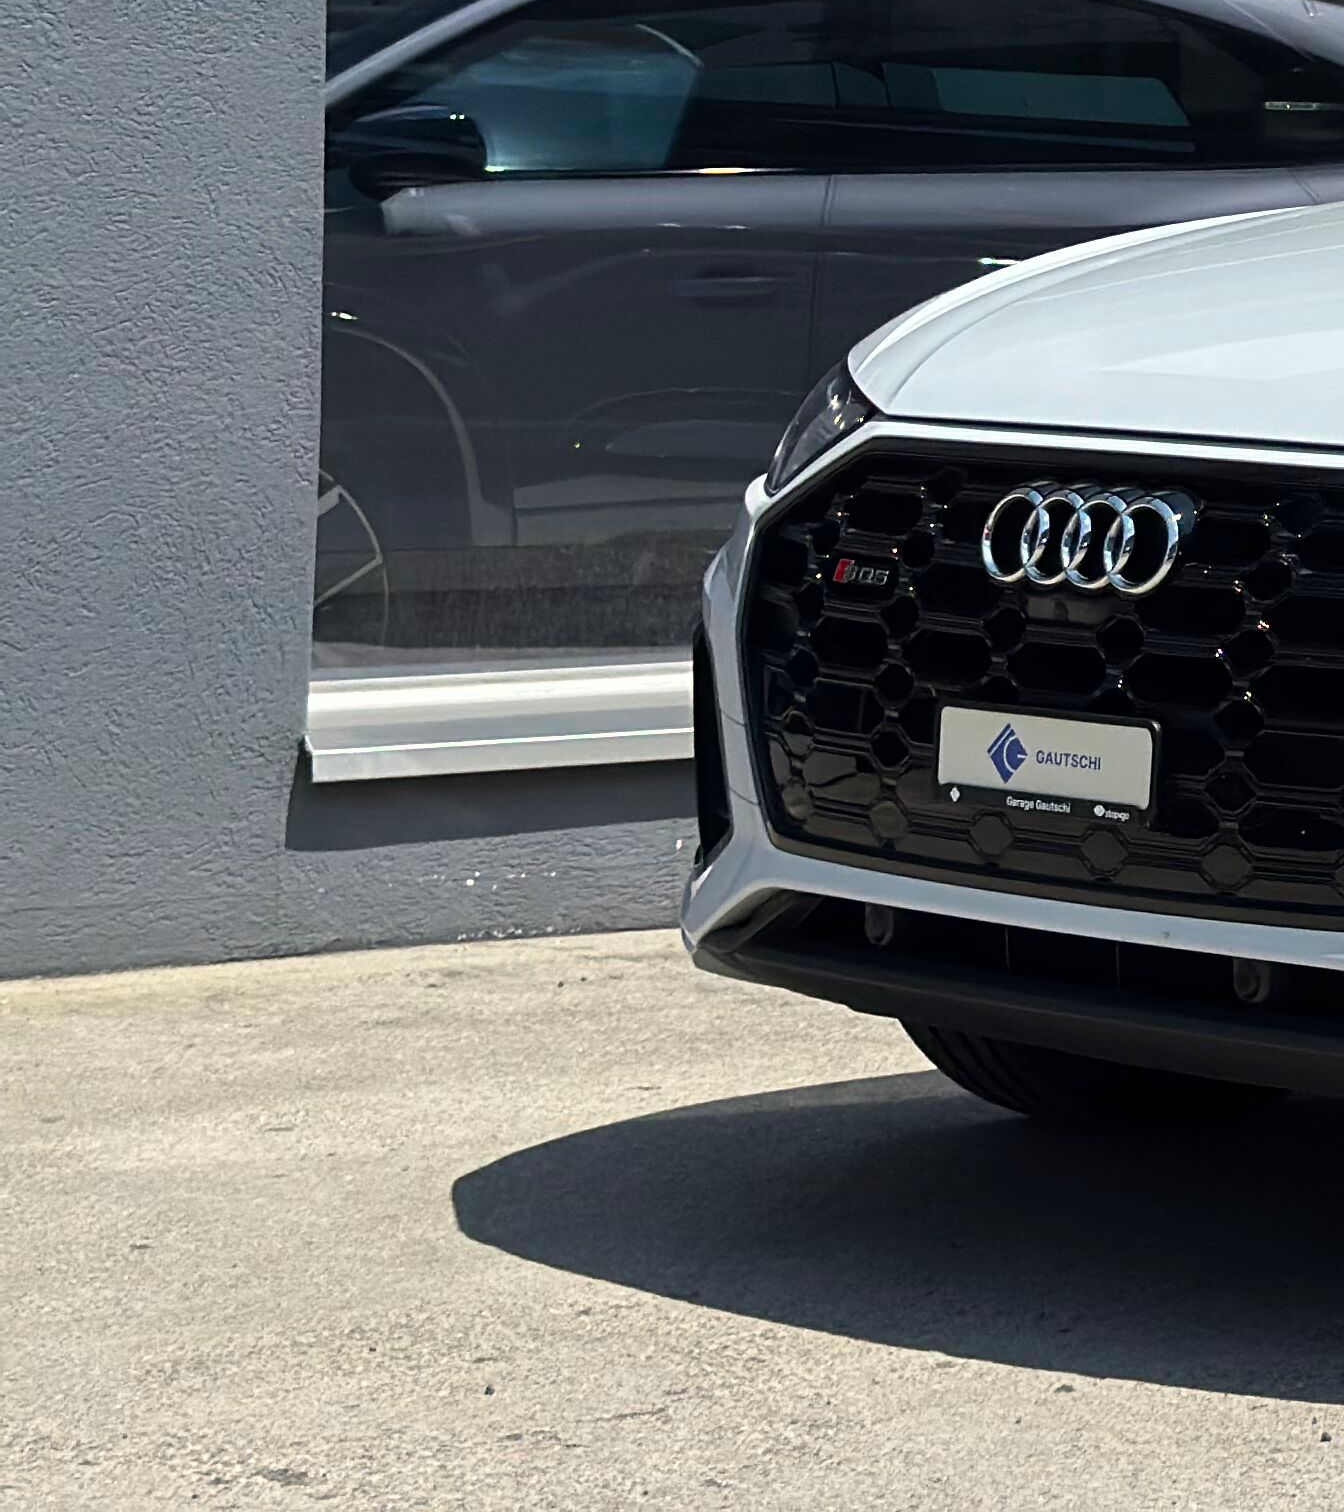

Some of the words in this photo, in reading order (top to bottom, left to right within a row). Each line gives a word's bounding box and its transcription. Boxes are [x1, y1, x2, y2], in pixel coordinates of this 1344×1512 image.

[1036, 750, 1101, 770] GAUTSCHI
[1006, 796, 1034, 810] Garage
[1035, 799, 1070, 813] Gautschi
